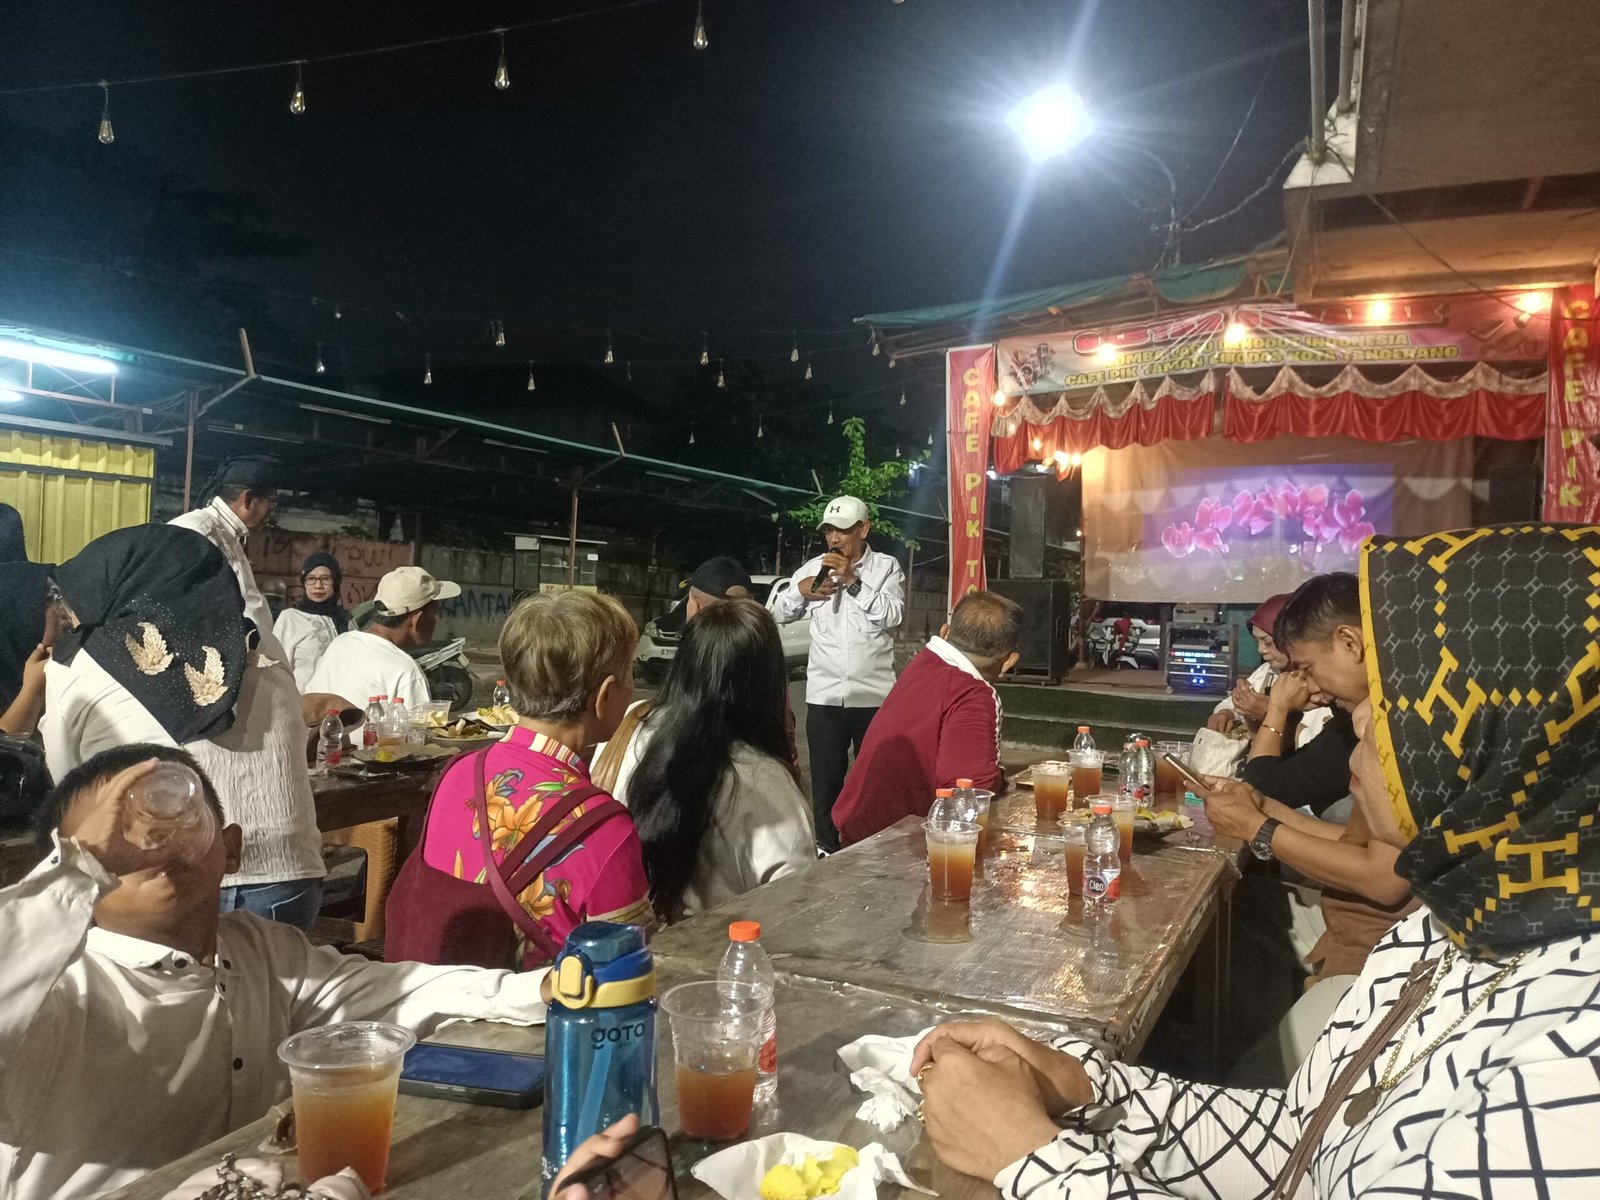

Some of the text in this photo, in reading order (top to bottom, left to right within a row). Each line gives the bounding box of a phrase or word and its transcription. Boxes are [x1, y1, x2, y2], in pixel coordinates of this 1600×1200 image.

[963, 367, 982, 453] CAFE
[1065, 371, 1106, 387] CAFE
[1109, 366, 1137, 380] PIK
[1559, 301, 1591, 508] CAFE PIK
[964, 472, 982, 538] PIK
